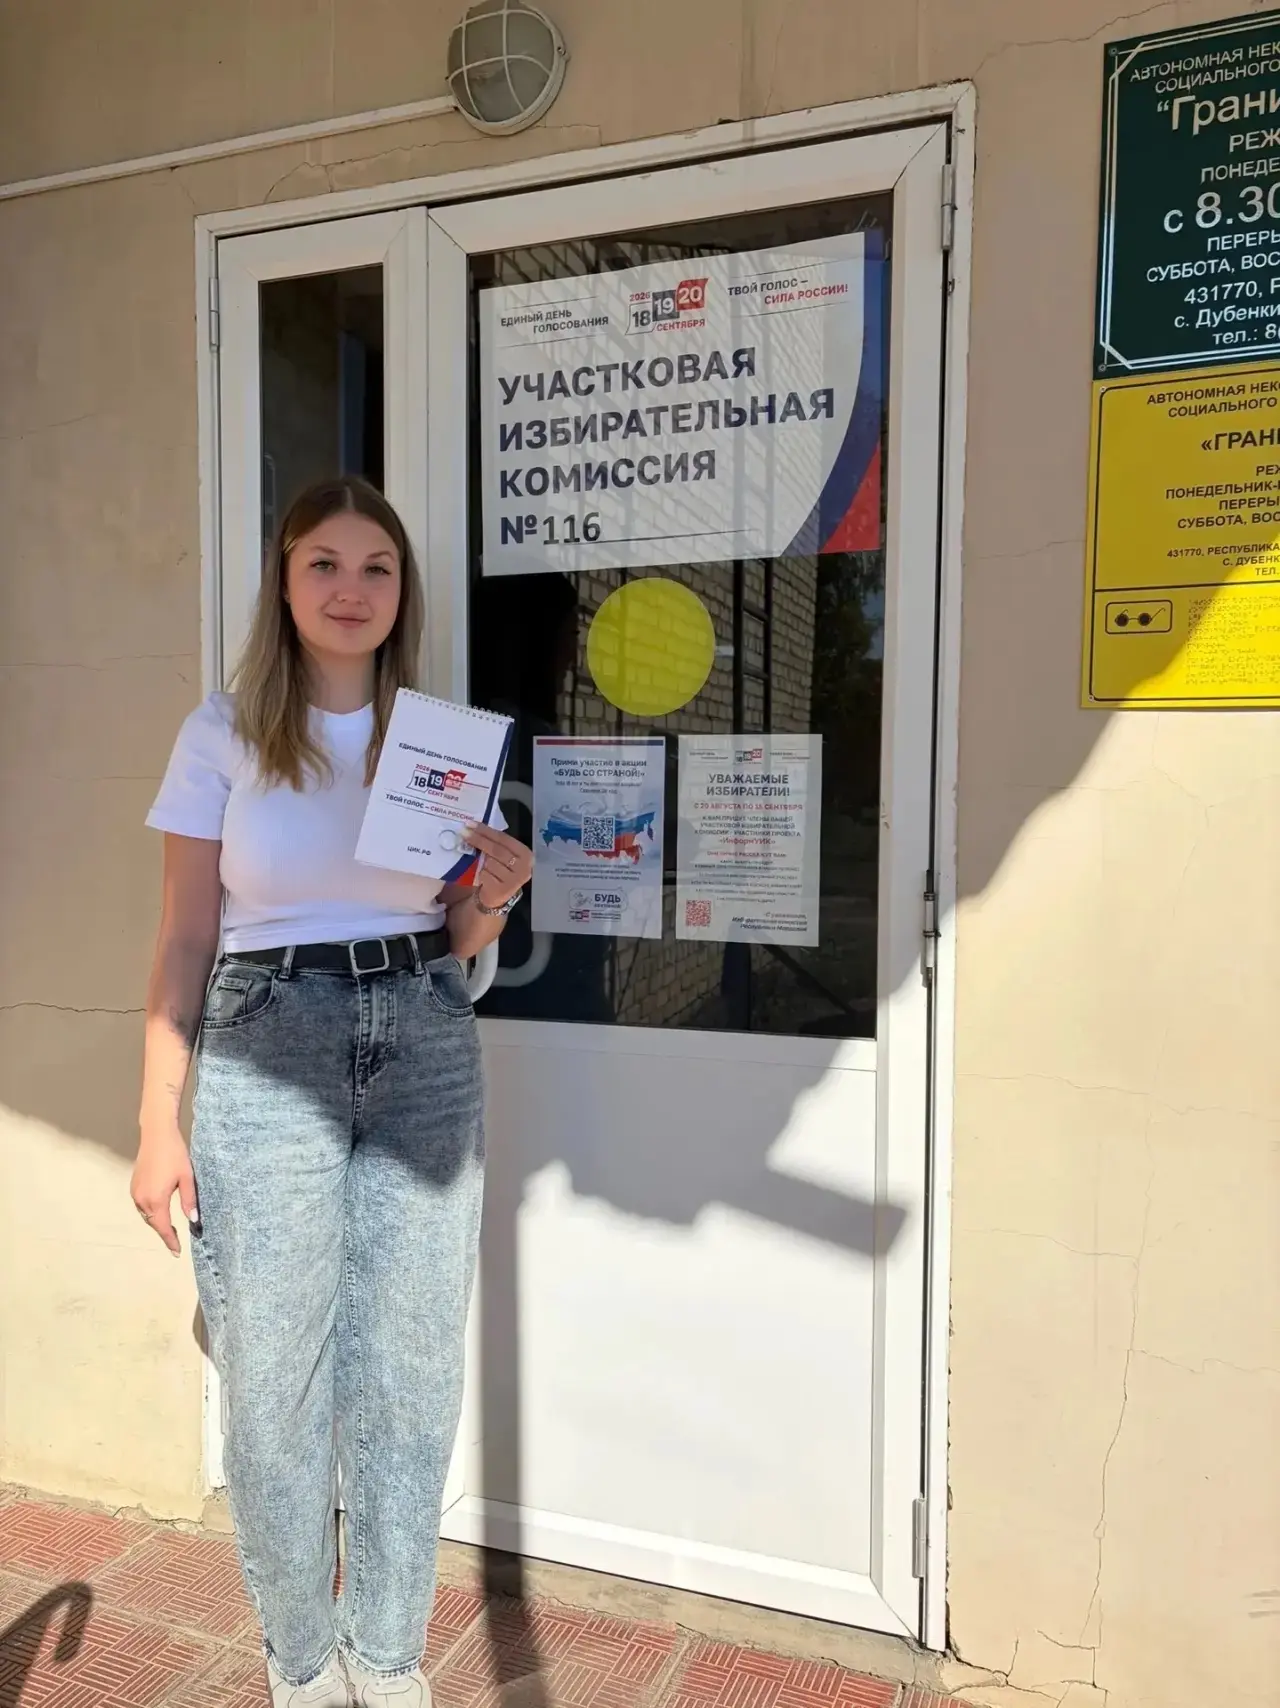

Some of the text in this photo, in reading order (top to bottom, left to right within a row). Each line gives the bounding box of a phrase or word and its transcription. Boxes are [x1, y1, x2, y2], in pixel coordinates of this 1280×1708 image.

[1130, 48, 1243, 82] АВТОНОМНАЯ
[1155, 58, 1280, 93] СОЦИАЛЬНОГО
[1200, 157, 1280, 183] ПОНЕДЕ
[1164, 210, 1183, 233] с
[1146, 258, 1235, 282] СУББОТА,
[728, 282, 758, 296] ТВОЙ
[760, 278, 798, 292] ГОЛОС
[764, 284, 849, 305] СИЛА РОССИИ!
[1184, 281, 1263, 304] 431770,
[629, 291, 651, 302] 2026
[632, 285, 703, 328] 18 19 20
[500, 309, 572, 327] ЕДИНЫЙ ДЕНЬ
[533, 316, 609, 334] ГОЛОСОВАНИЯ
[656, 318, 706, 332] СЕНТЯБРЯ
[1174, 304, 1280, 328] с. Дубенки
[1212, 328, 1258, 345] тел.:
[498, 346, 756, 405] УЧАСТКОВАЯ
[1147, 381, 1280, 405] АВТОНОМНАЯ НЕК
[1168, 397, 1278, 418] СОЦИАЛЬНОГО
[500, 388, 835, 452] ИЗБИРАТЕЛЬНАЯ
[1201, 428, 1280, 451] «ГРАН
[500, 450, 716, 499] КОМИССИЯ
[1219, 496, 1280, 511] ПЕРЕРЫ
[1178, 515, 1247, 529] СУББОТА,
[1222, 558, 1233, 566] С.
[398, 742, 488, 772] ЕДИНЫЙ ДЕНЬ ГОЛОСОВАНИЯ
[551, 758, 578, 767] Прими
[414, 776, 427, 788] 18
[430, 775, 443, 786] 19
[554, 769, 581, 777] «БУДЬ
[582, 769, 595, 777] СО
[709, 774, 789, 784] УВАЖАЕМЫЕ
[427, 789, 459, 802] СЕНТЯБРЯ
[706, 786, 790, 797] ИЗБИРАТЕЛИ!
[386, 793, 403, 804] ТВОЙ
[403, 799, 424, 809] ГОЛОС
[430, 805, 448, 815] СИЛА
[764, 803, 803, 811] СЕНТЯБРЯ
[407, 846, 432, 856] ЦИК.РФ
[594, 893, 621, 904] БУДЬ
